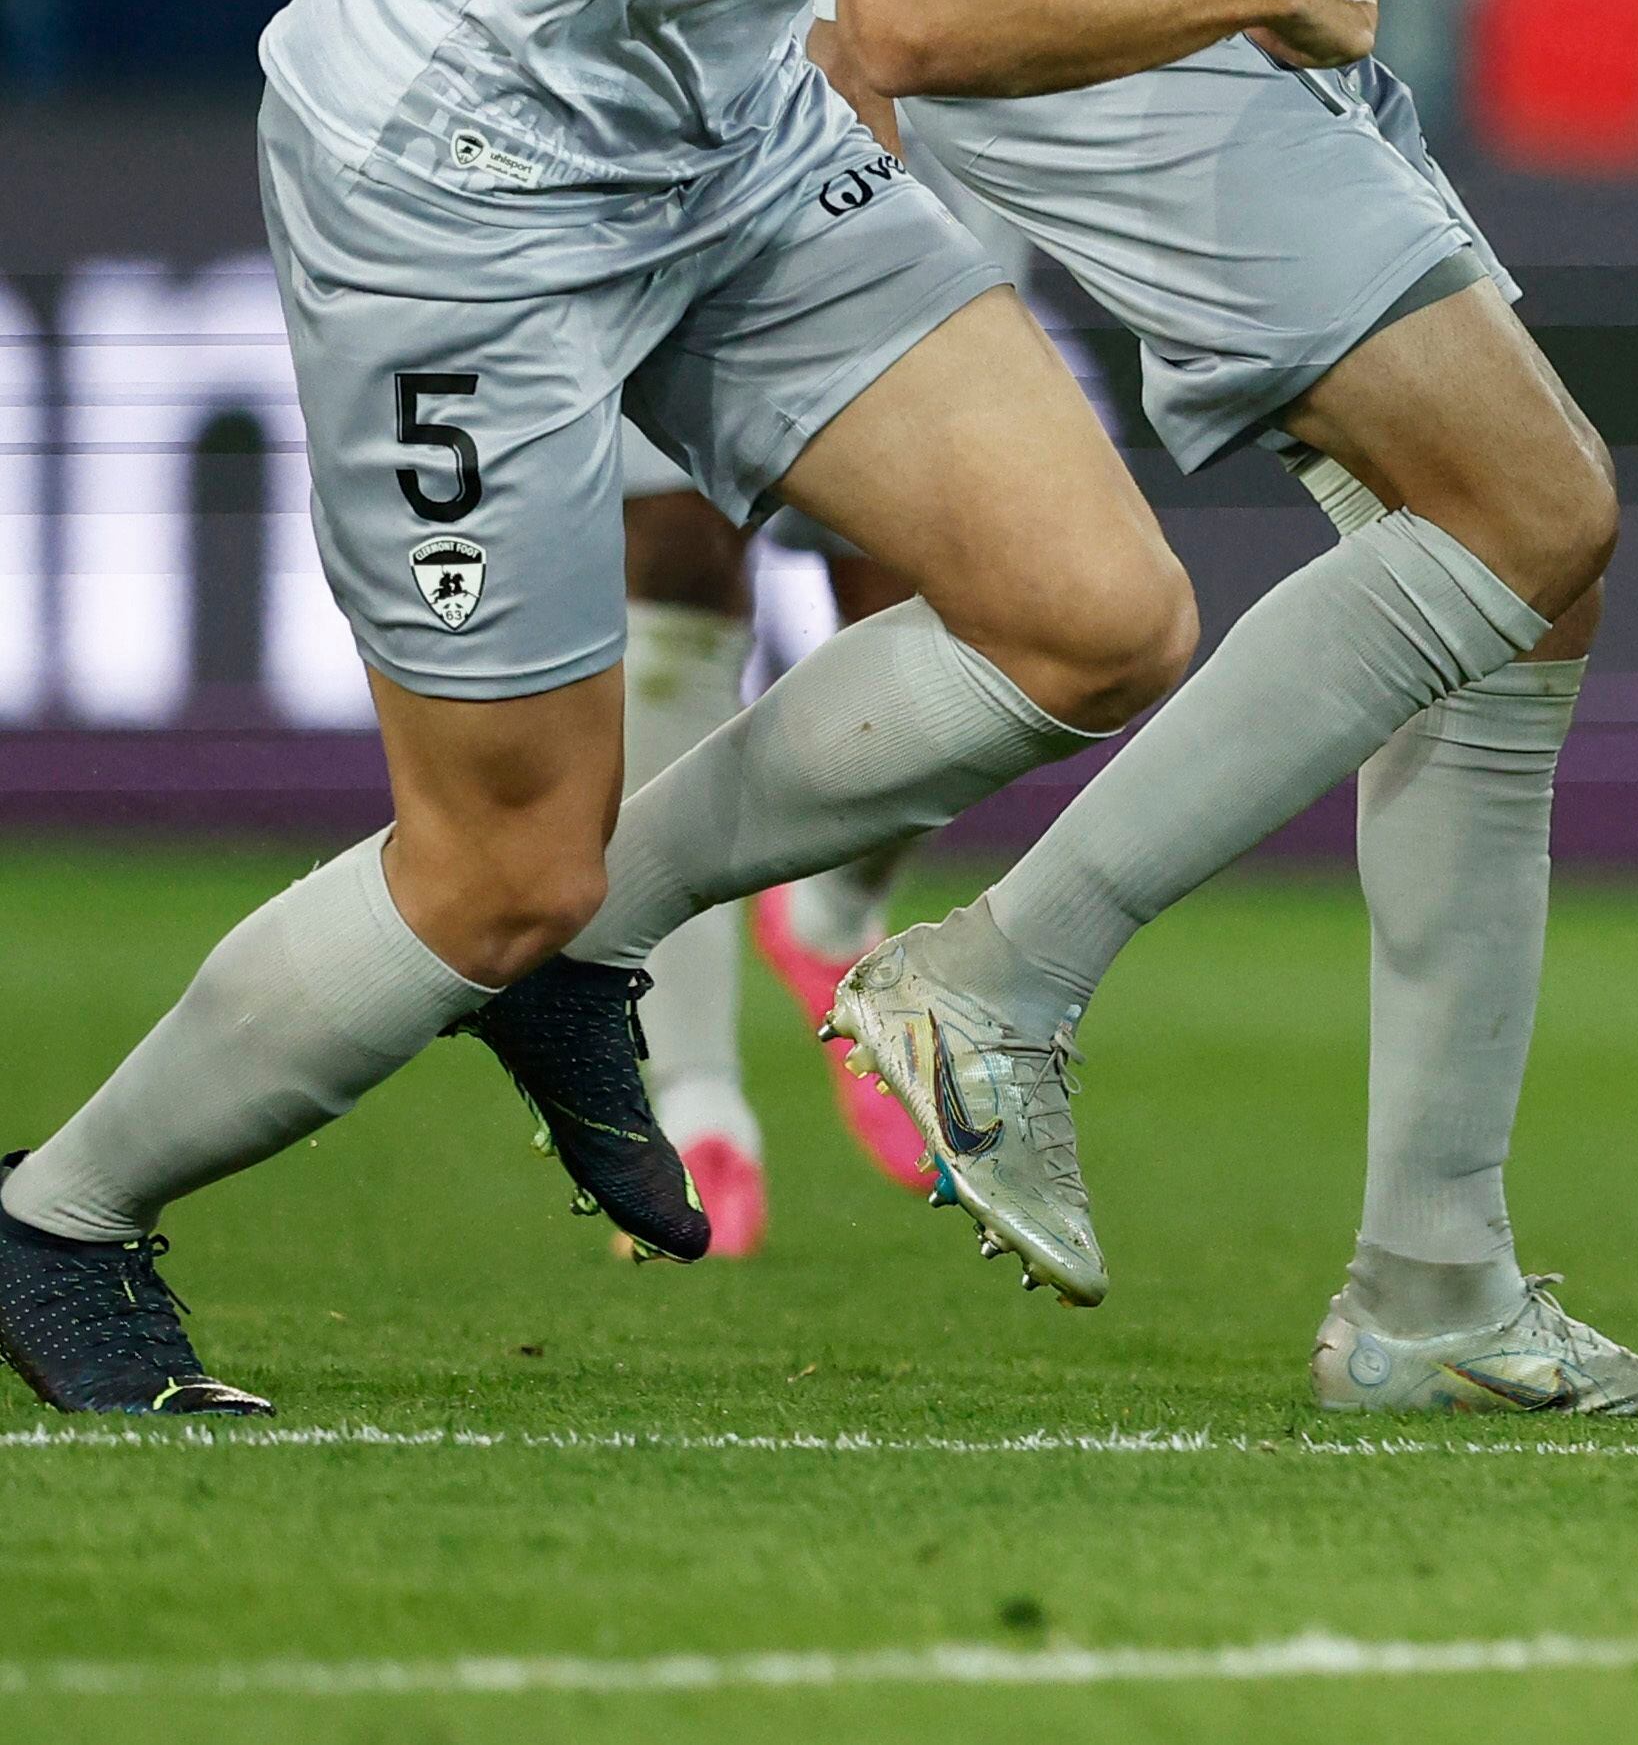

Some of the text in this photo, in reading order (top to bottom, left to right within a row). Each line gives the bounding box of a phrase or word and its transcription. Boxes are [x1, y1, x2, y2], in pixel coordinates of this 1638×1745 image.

[490, 152, 532, 173] uhlsport
[394, 373, 482, 522] 5
[415, 542, 479, 561] CLERMONT FOOT
[445, 610, 463, 621] 63
